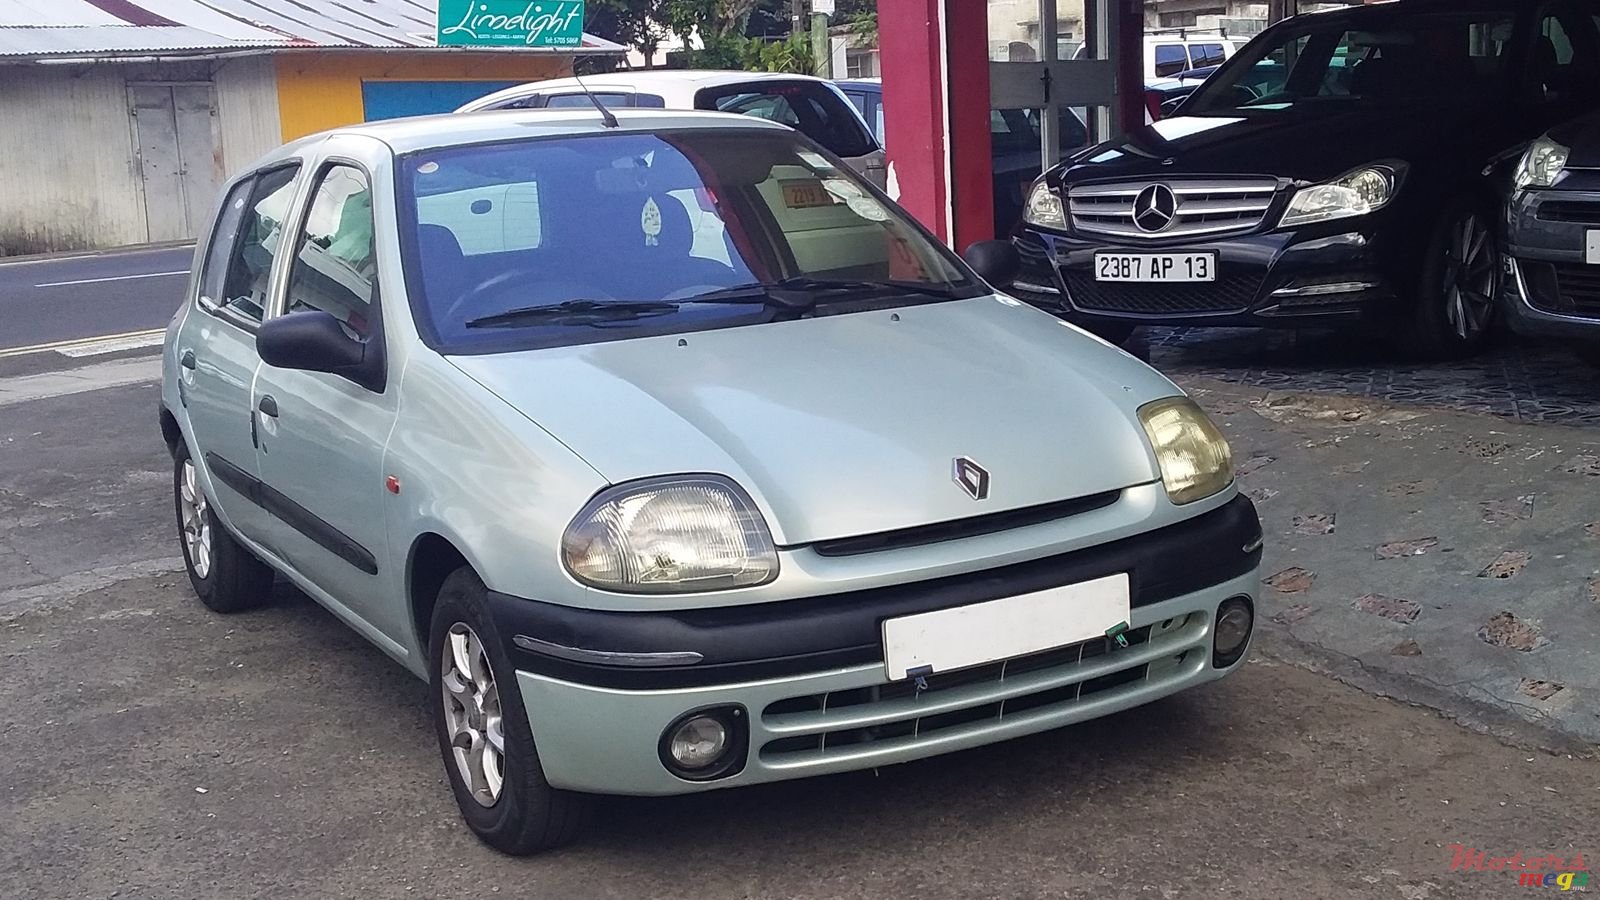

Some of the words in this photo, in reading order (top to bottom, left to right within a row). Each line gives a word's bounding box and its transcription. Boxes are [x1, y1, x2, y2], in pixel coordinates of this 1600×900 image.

[441, 0, 581, 44] Limelight
[1100, 257, 1141, 278] 2387
[1150, 257, 1174, 279] AP
[1184, 257, 1208, 278] 13
